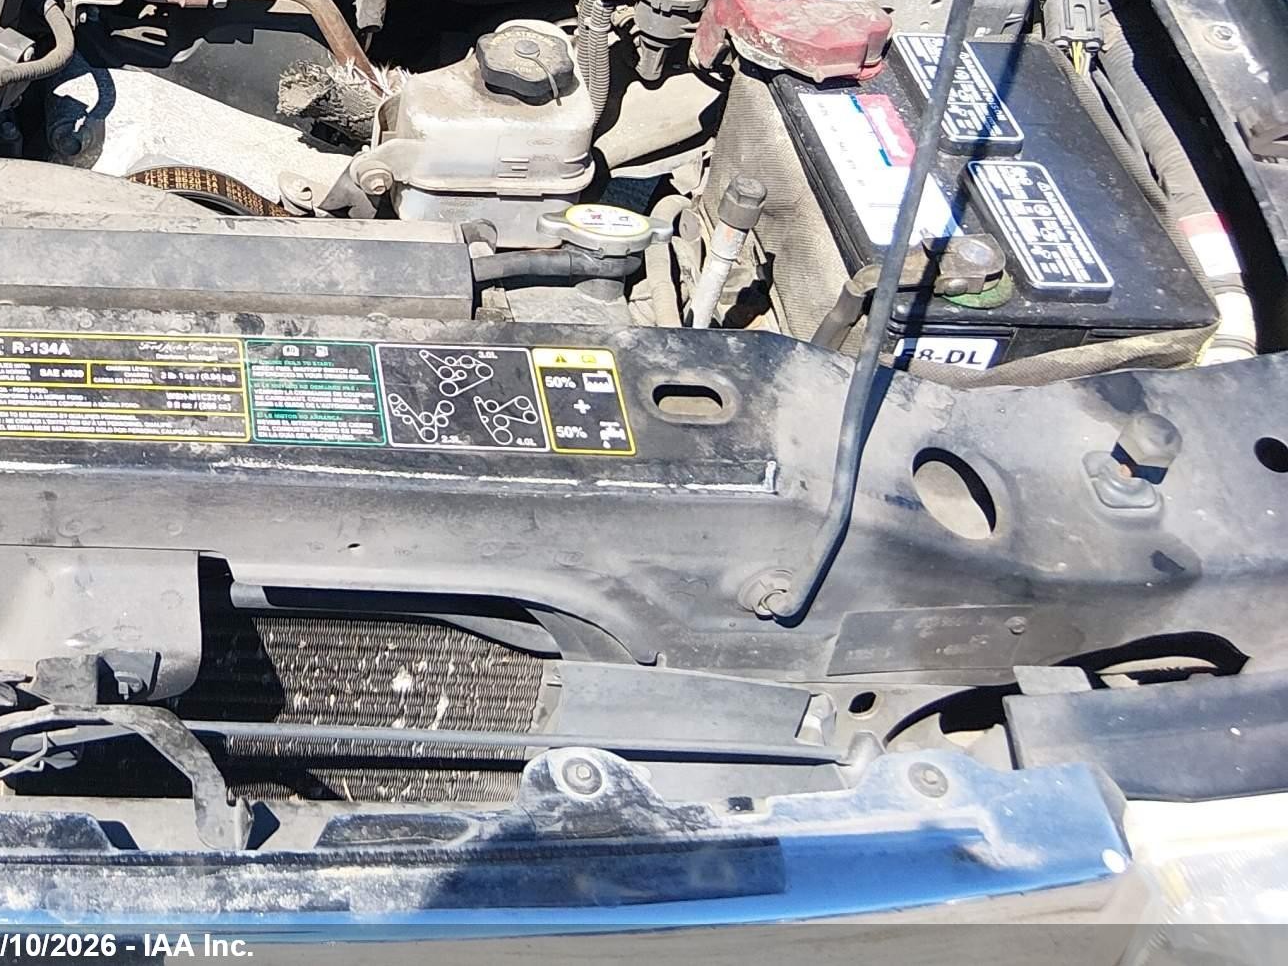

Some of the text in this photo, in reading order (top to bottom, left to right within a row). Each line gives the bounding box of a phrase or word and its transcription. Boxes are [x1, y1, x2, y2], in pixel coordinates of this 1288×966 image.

[12, 341, 71, 355] R-134A
[545, 375, 577, 389] 50%
[555, 426, 588, 439] 50%
